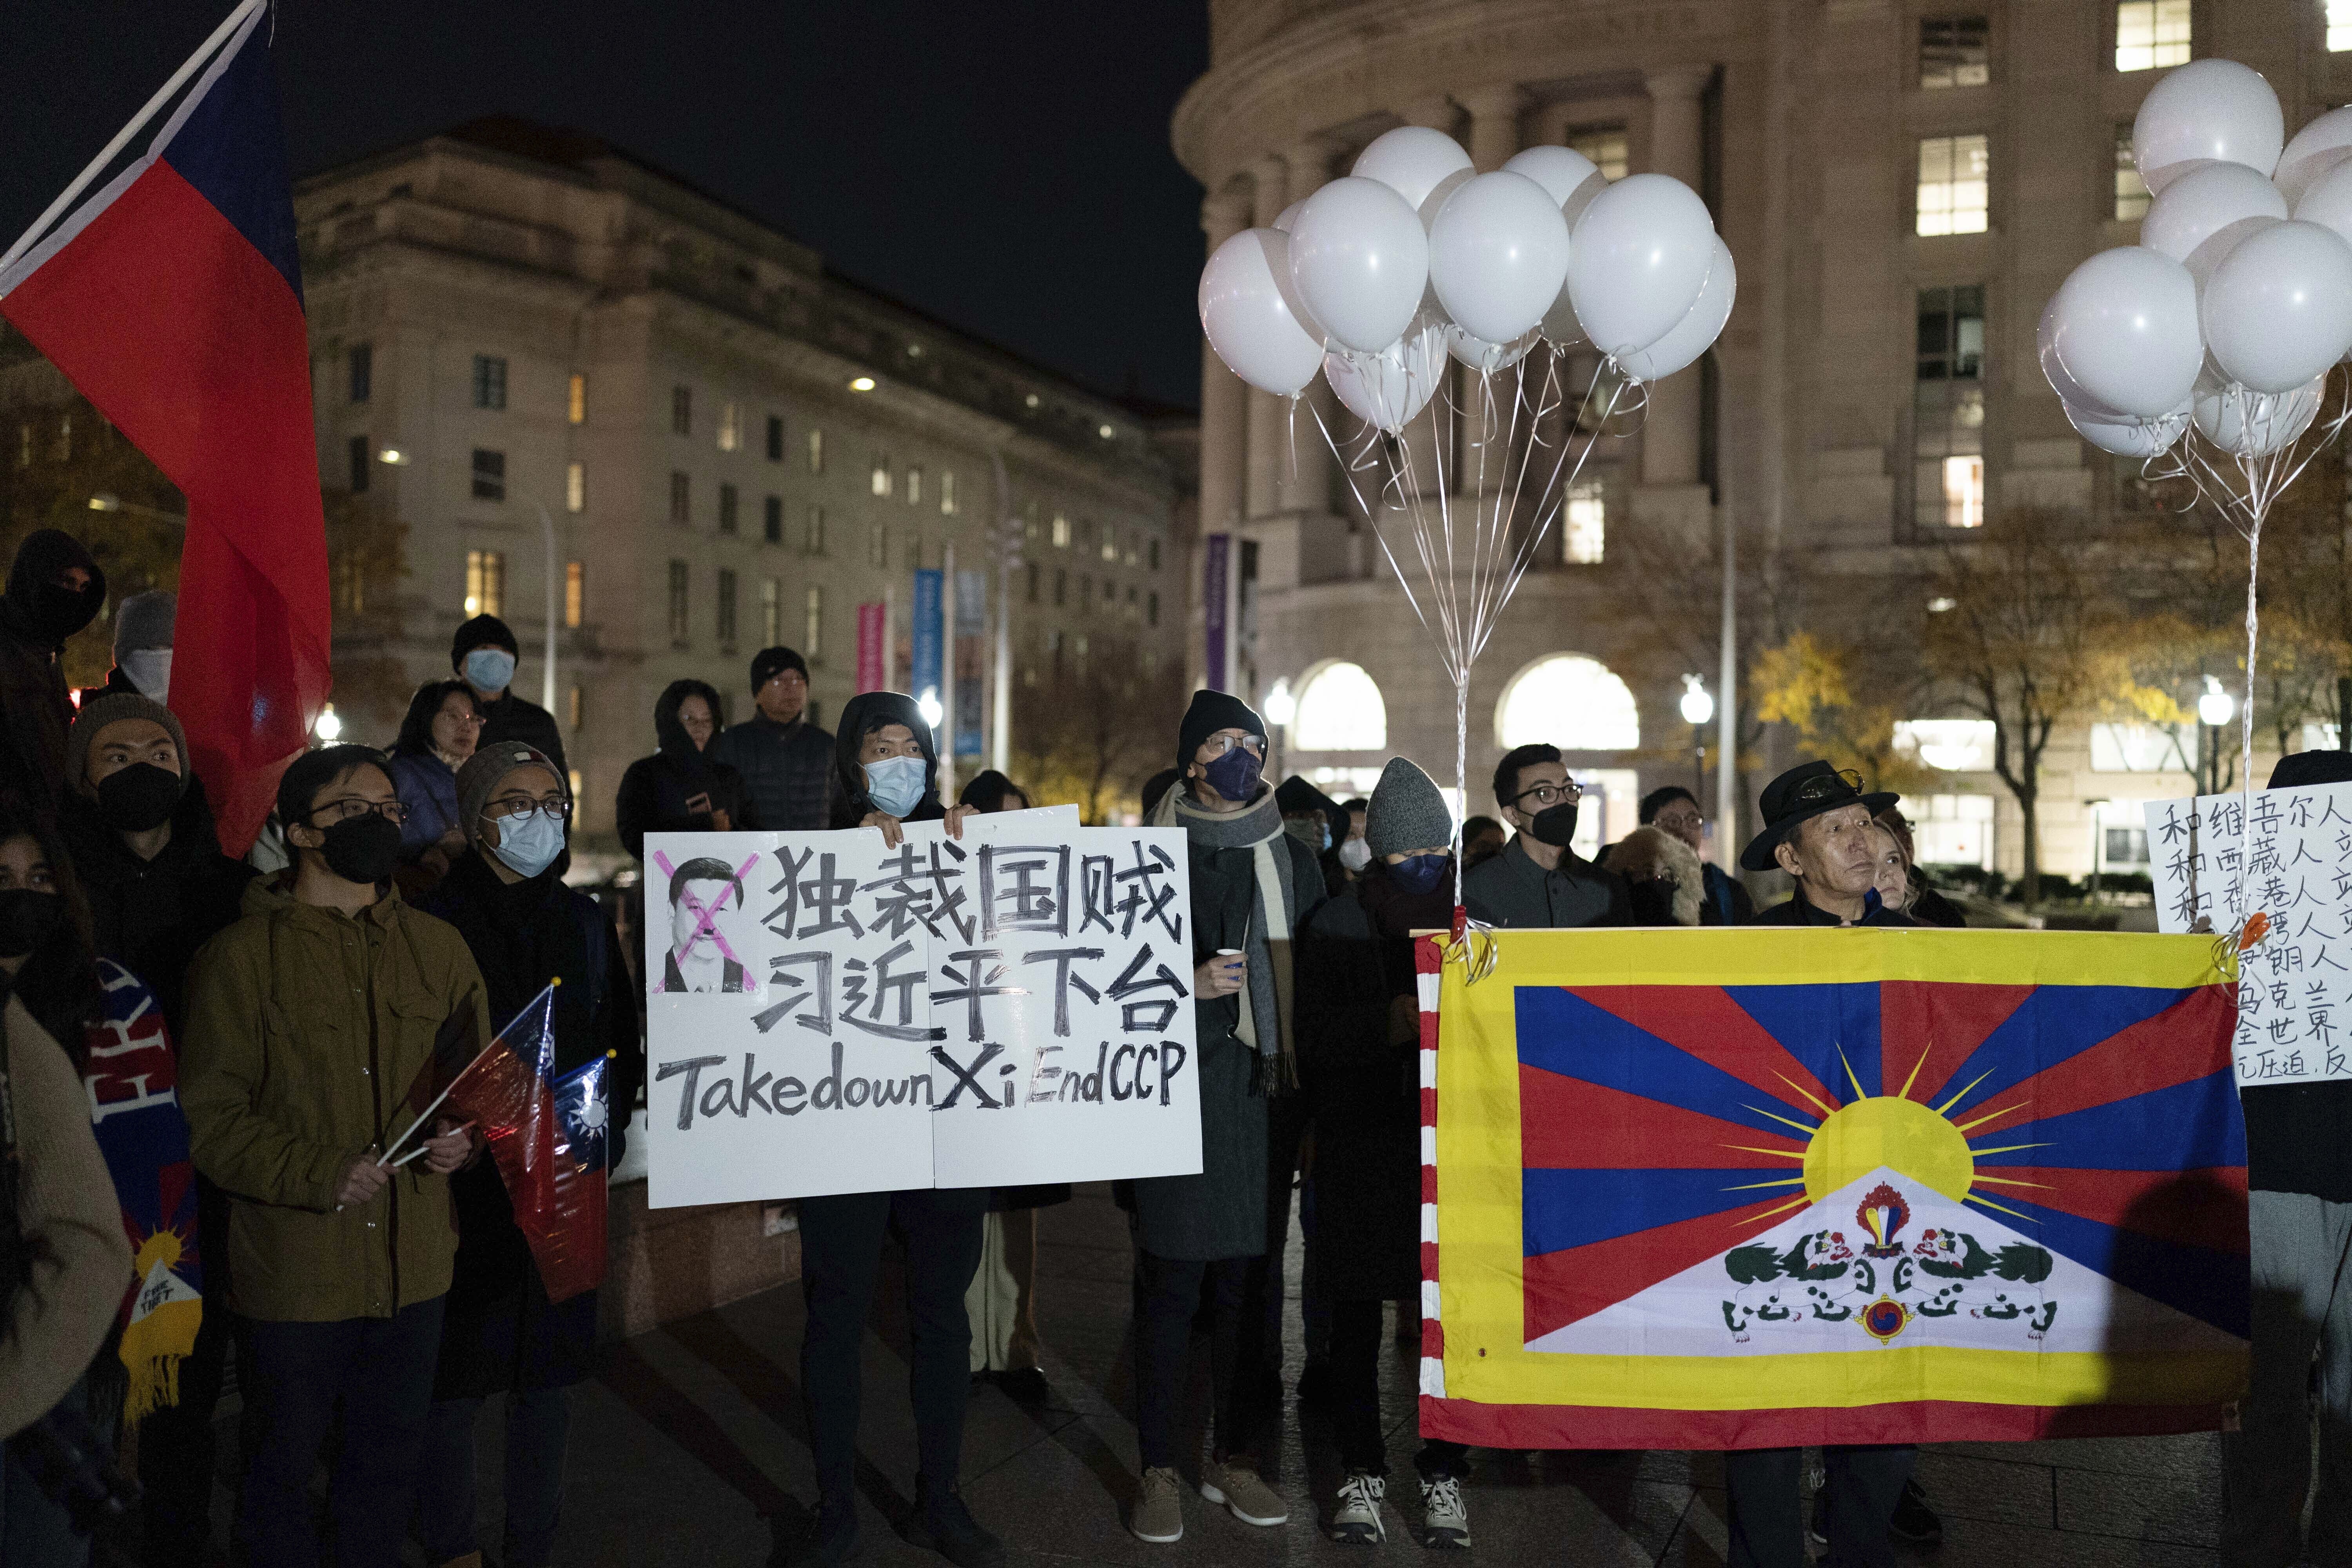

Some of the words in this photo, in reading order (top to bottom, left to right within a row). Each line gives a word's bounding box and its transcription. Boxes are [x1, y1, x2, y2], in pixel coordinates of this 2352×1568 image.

[760, 840, 1182, 946] 独裁国贼
[750, 940, 1189, 1042] 习近平下台
